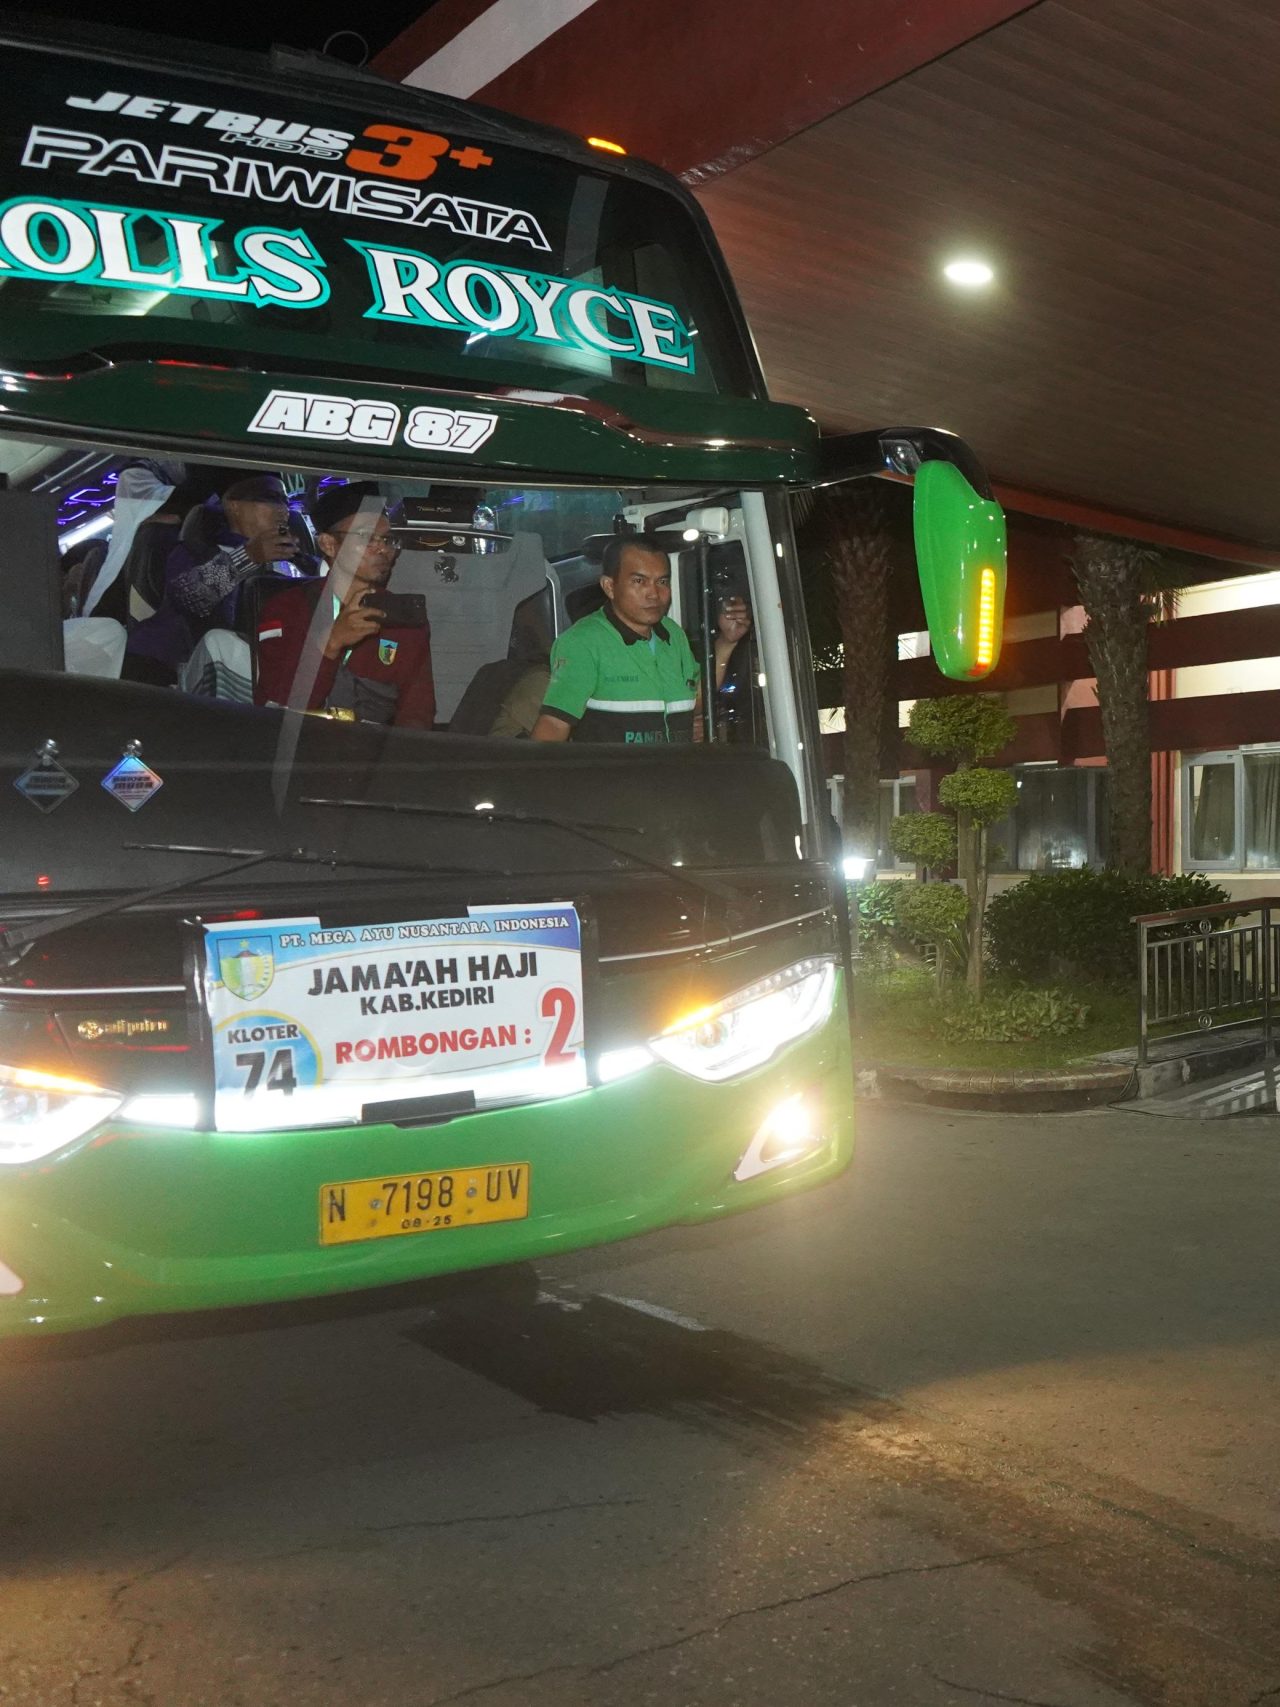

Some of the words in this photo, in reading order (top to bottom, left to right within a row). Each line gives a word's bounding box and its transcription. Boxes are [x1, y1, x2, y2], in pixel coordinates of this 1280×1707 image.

[65, 91, 356, 150] JETBUS
[20, 125, 552, 252] PARIWISATA
[0, 199, 328, 308] OLLS
[350, 242, 693, 371] ROYCE
[250, 391, 399, 444] ABG
[405, 407, 497, 453] 87
[279, 934, 305, 948] PT.
[310, 930, 355, 946] MEGA
[360, 926, 395, 942] AYU
[399, 920, 491, 939] NUSANTARA
[494, 915, 570, 934] INDONESIA
[307, 956, 459, 997] JAMA'AH
[468, 951, 539, 981] HAJI
[360, 986, 495, 1016] KAB.KEDIRI
[227, 1023, 299, 1045] KLOTER
[335, 1024, 517, 1065] ROMBONGAN
[541, 986, 577, 1067] 2
[235, 1048, 298, 1099] 74
[328, 1188, 346, 1224] N
[382, 1175, 454, 1216] 7198
[486, 1167, 521, 1202] UV
